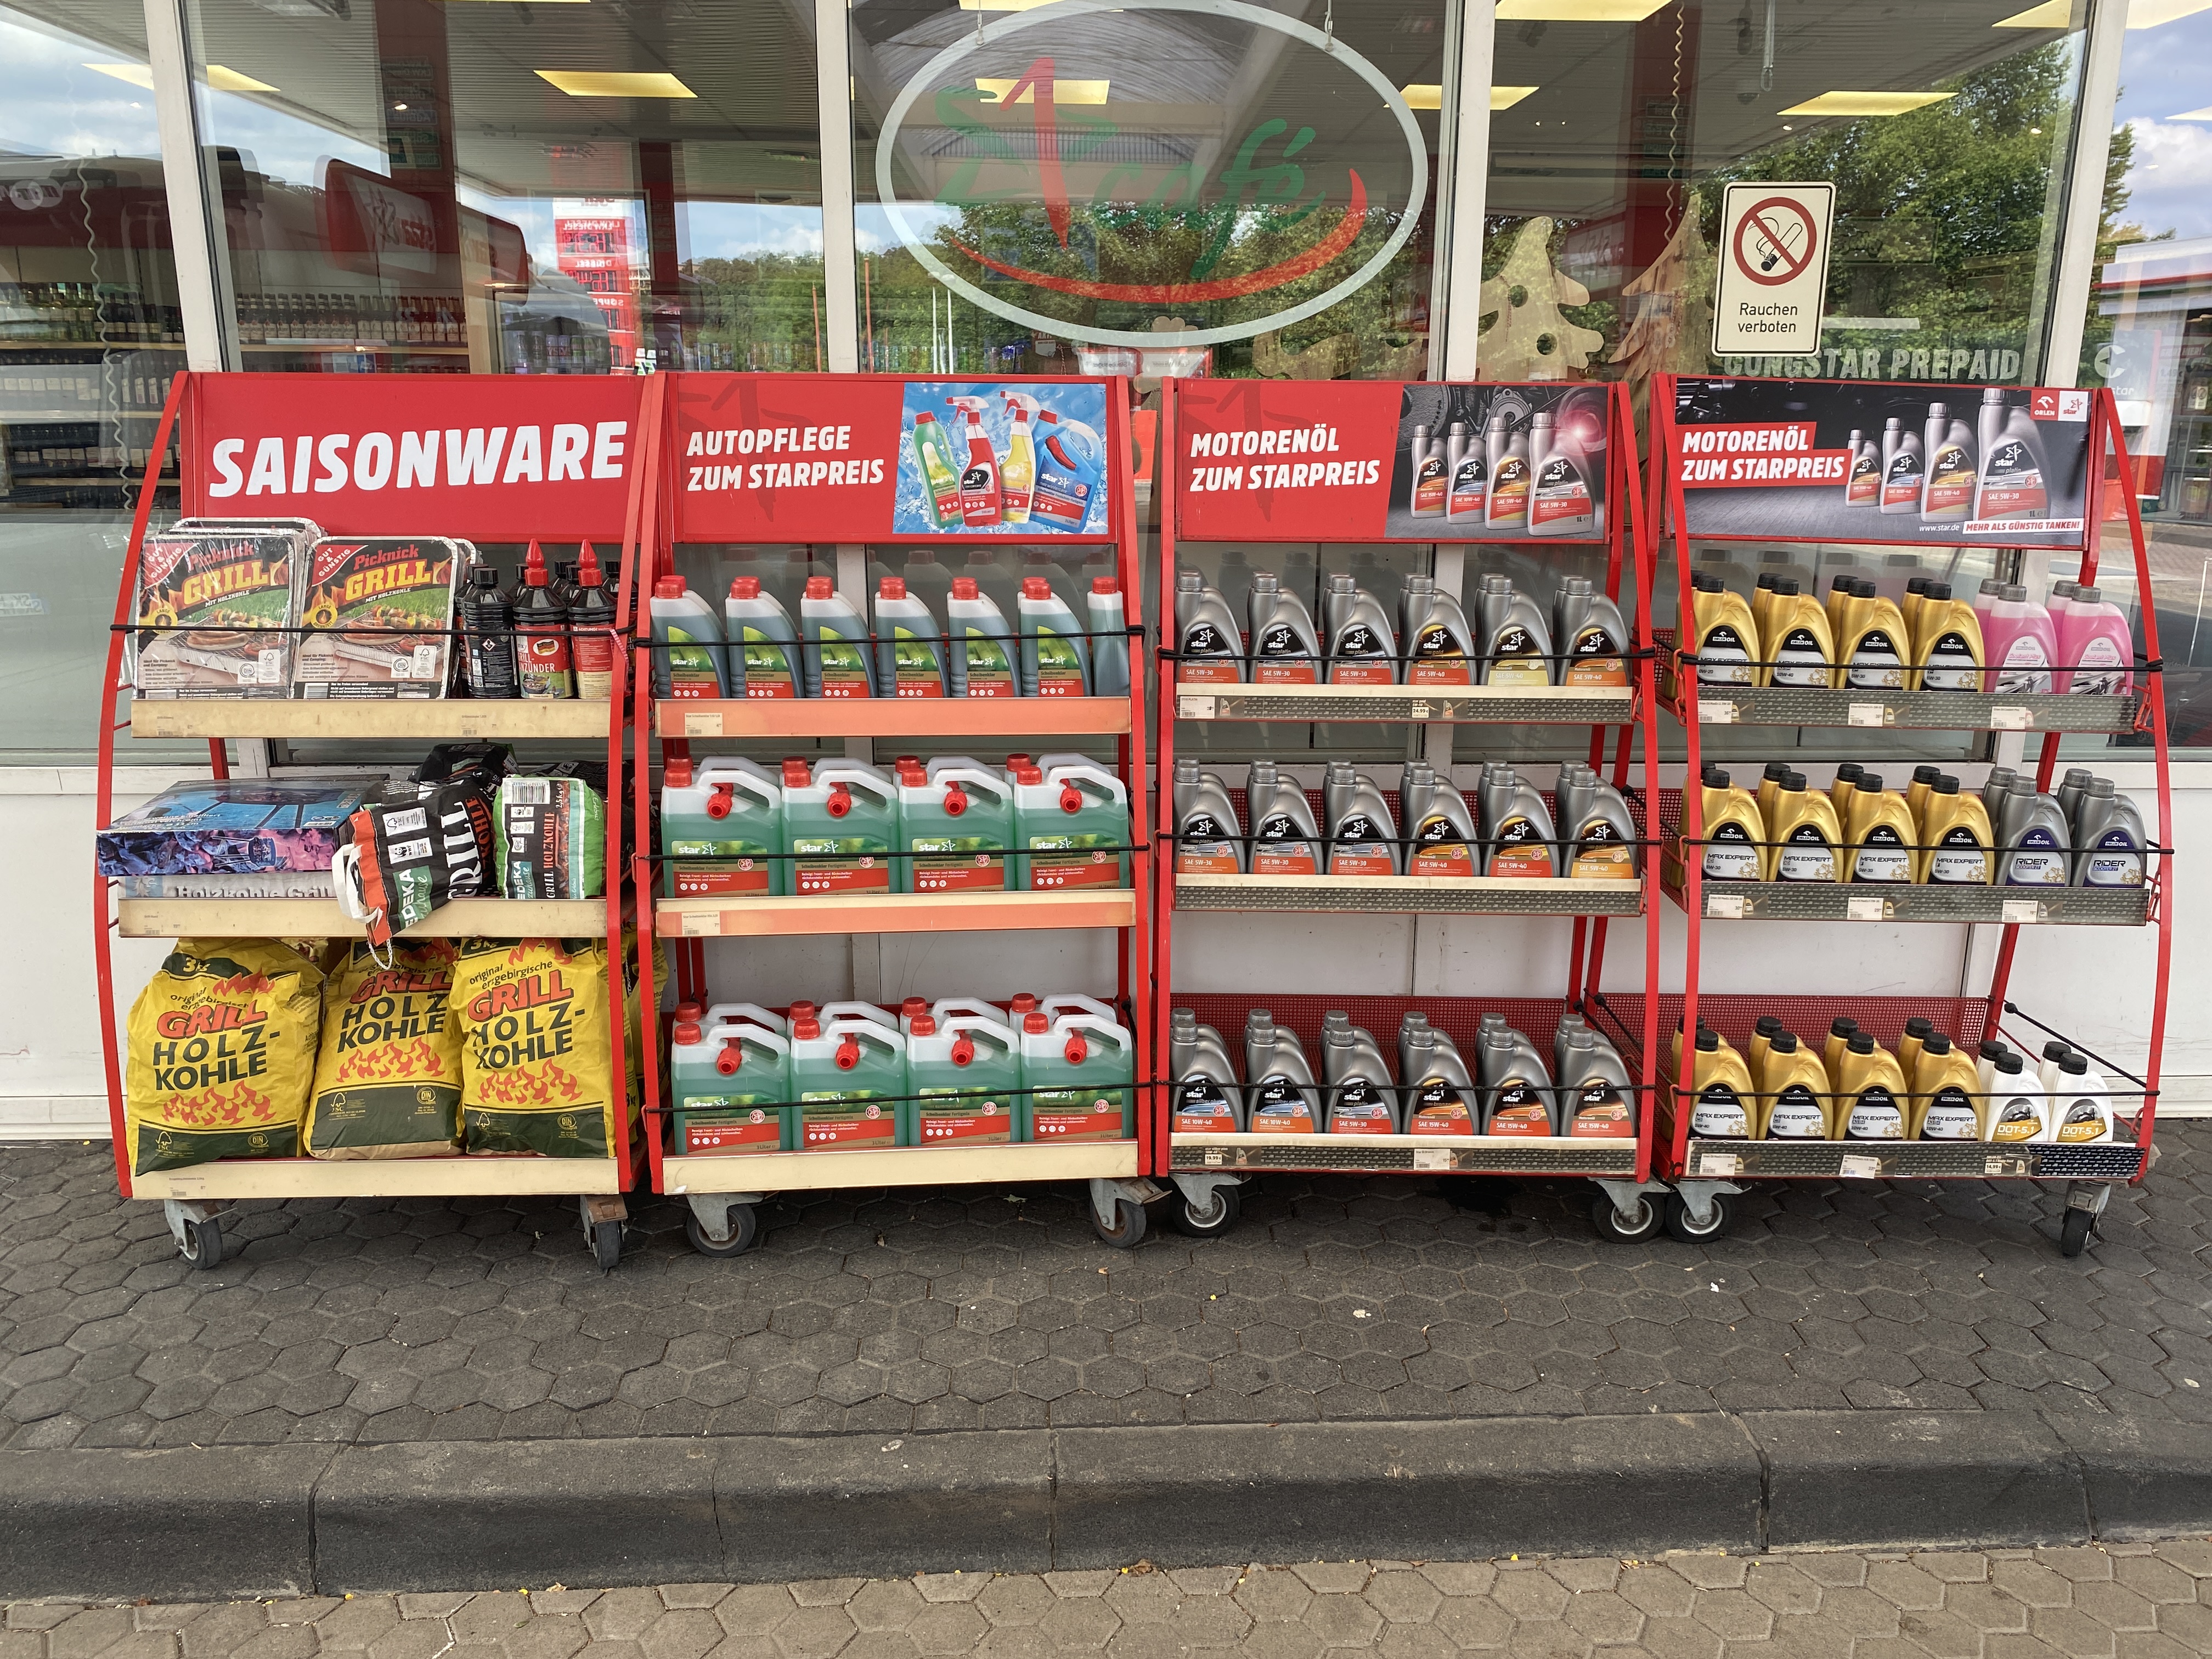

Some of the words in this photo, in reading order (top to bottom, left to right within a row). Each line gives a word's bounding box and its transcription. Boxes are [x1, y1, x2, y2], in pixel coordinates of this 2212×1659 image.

[1740, 302, 1798, 316] Rauchen
[1738, 319, 1797, 333] verboten
[1890, 348, 2020, 380] PREPAID
[686, 425, 851, 456] AUTOPFLEGE
[1190, 424, 1340, 458] MOTORENÖL
[1683, 425, 1809, 453] MOTORENÖL
[209, 421, 628, 498] SAISONWARE
[1682, 459, 1735, 481] ZUM
[1735, 456, 1845, 479] STARPREIS
[1995, 459, 2015, 467] star
[687, 466, 748, 492] ZUM
[749, 459, 884, 489] STARPREIS
[1041, 473, 1058, 483] star
[1190, 466, 1247, 492] ZUM
[1249, 460, 1380, 490] STARPREIS
[1966, 522, 1990, 531] MEHR
[1991, 522, 2006, 531] ALS
[2008, 521, 2043, 531] GÜNSTIG
[2046, 521, 2080, 529] TANKEN!
[317, 547, 333, 562] GUT
[318, 548, 351, 577] GÜNSTIG
[353, 544, 419, 571] Picknick
[183, 561, 268, 605] GRILL
[345, 560, 432, 602] GRILL
[365, 594, 377, 603] MIT
[377, 588, 411, 600] HOLZKOHLE
[205, 598, 217, 607] MIT
[217, 590, 250, 603] HOLZKOHLE
[543, 811, 555, 868] HOLZKOHLE
[679, 845, 701, 854] star
[801, 844, 822, 853] star
[919, 843, 940, 851] star
[177, 885, 278, 898] Holzkohle
[287, 884, 331, 898] Grill
[517, 861, 526, 899] EDEKA
[546, 868, 555, 899] GRILL
[397, 868, 418, 928] EDEKA
[349, 970, 454, 1003] GRILL
[470, 964, 504, 985] original
[481, 961, 553, 990] erzgebirgische
[170, 987, 207, 1005] original
[467, 969, 574, 1022] GRILL
[157, 1000, 268, 1039] GRILL
[336, 1013, 445, 1053] KOHLE
[472, 1001, 586, 1047] HOLZ-
[153, 1025, 280, 1065] HOLZ-
[473, 1027, 574, 1070] KOHLE
[155, 1050, 267, 1091] KOHLE
[562, 1117, 573, 1126] DIN
[1997, 1125, 2035, 1135] DOT-5.1
[2062, 1126, 2100, 1136] DOT-5.1
[252, 1136, 263, 1144] DIN
